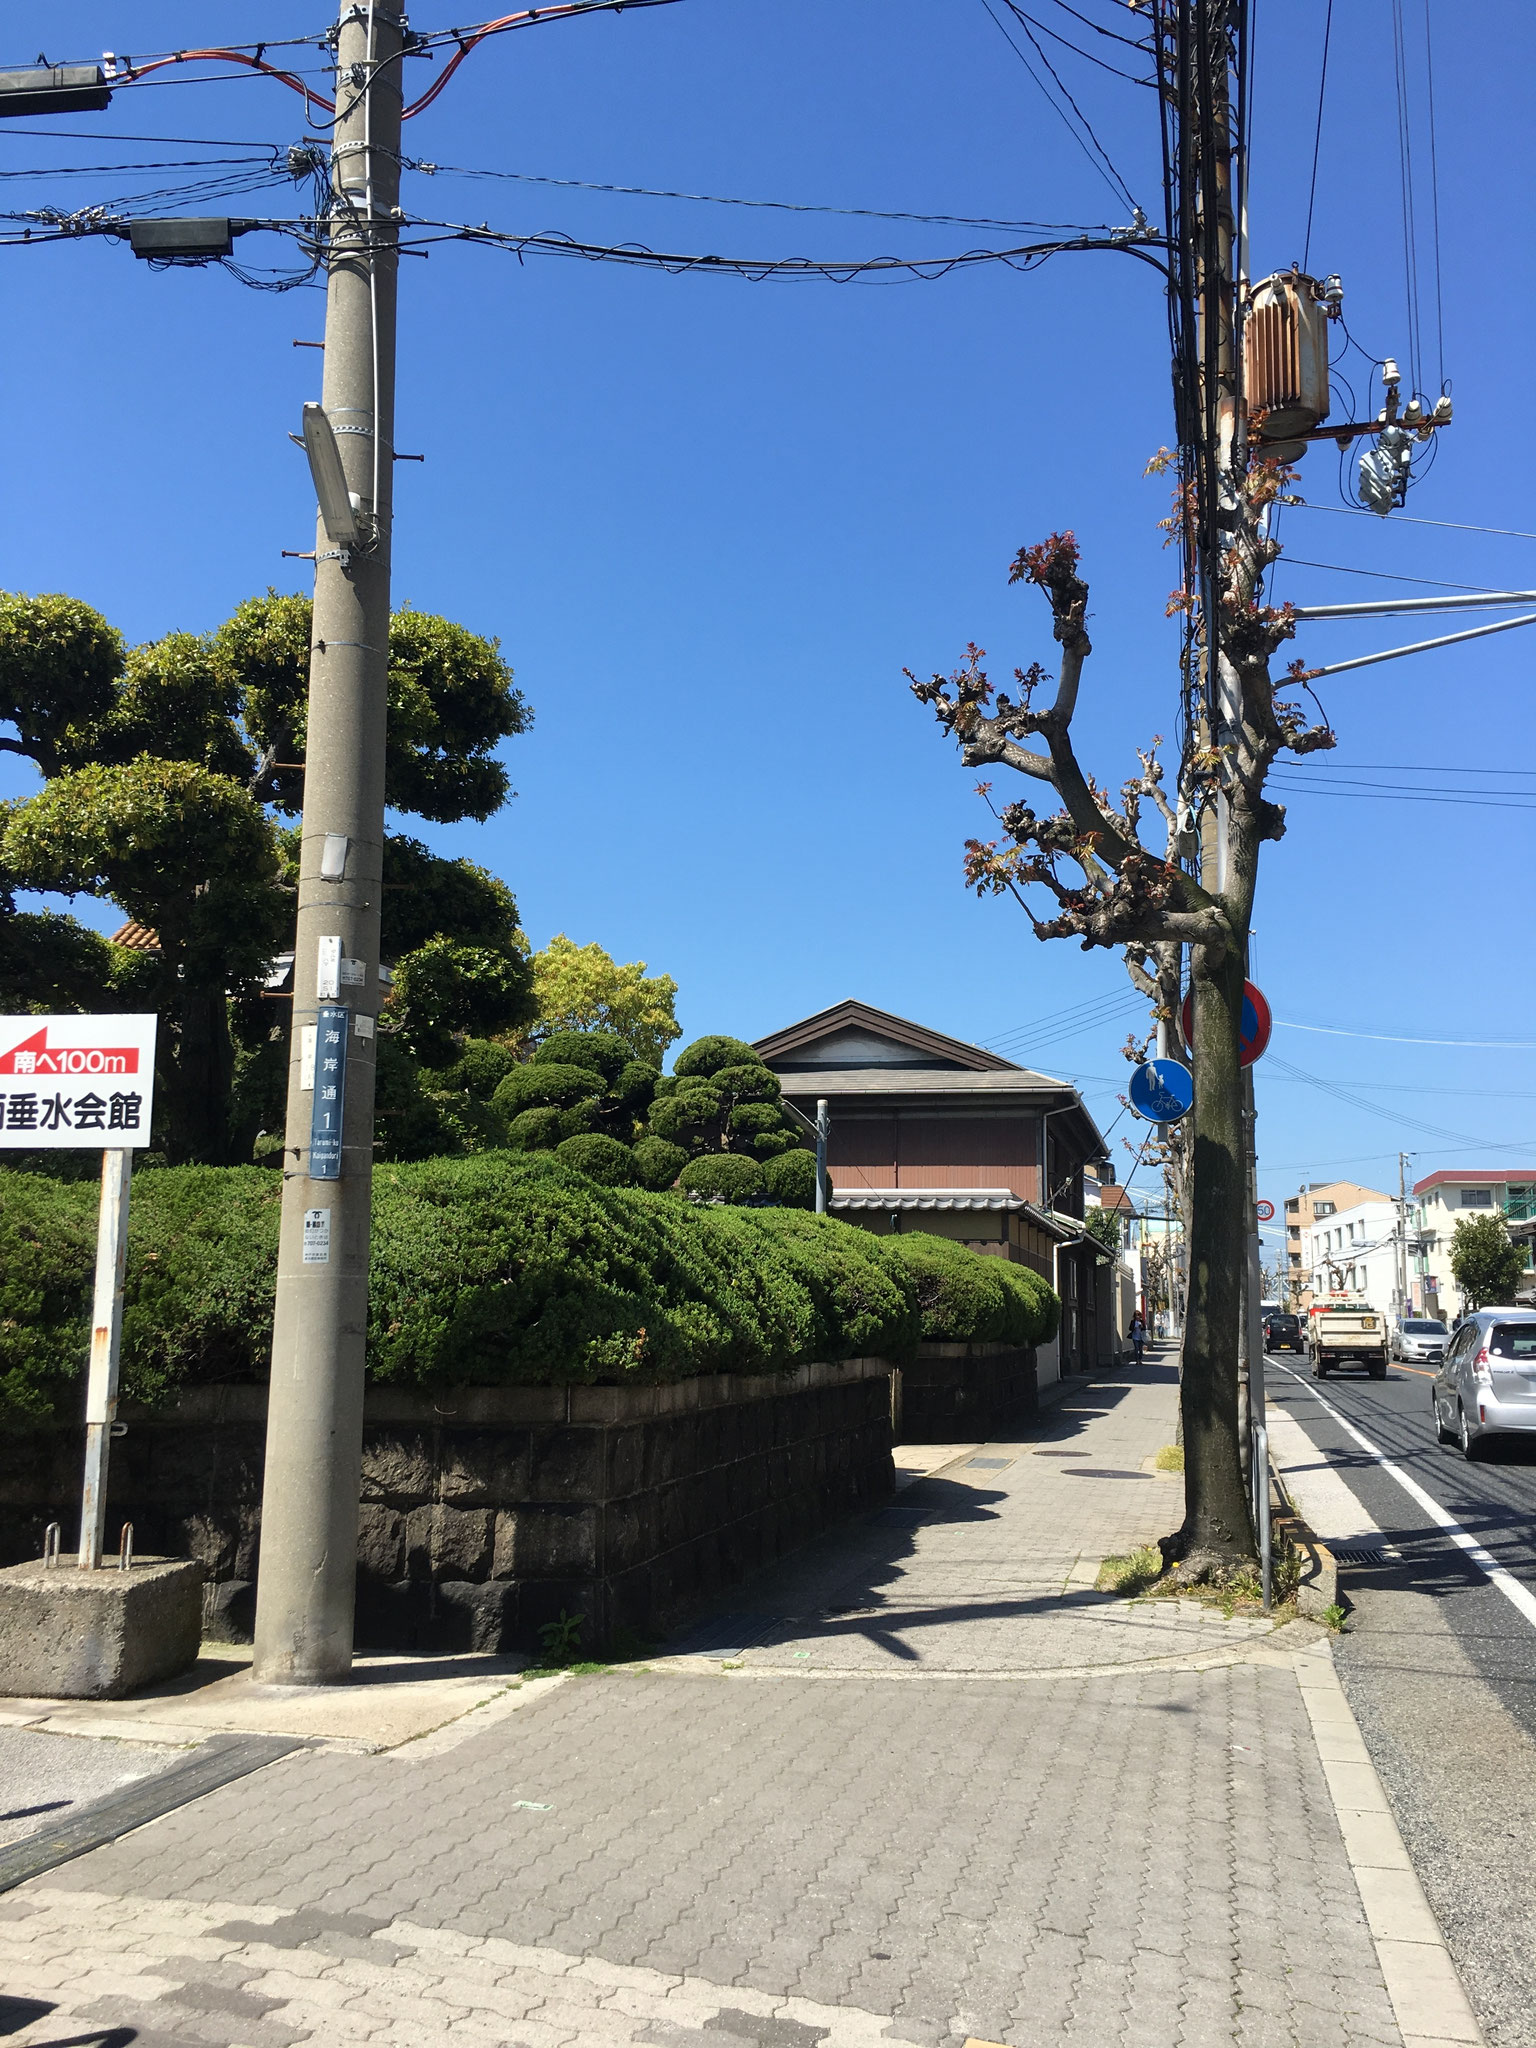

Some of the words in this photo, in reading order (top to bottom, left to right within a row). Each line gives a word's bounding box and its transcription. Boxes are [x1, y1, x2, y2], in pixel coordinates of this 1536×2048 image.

[14, 1050, 126, 1073] 南へ100m
[0, 1091, 142, 1130] 垂水会館
[314, 1138, 339, 1147] Tarumi-ku
[321, 1165, 327, 1174] 1
[1257, 1205, 1271, 1216] 50
